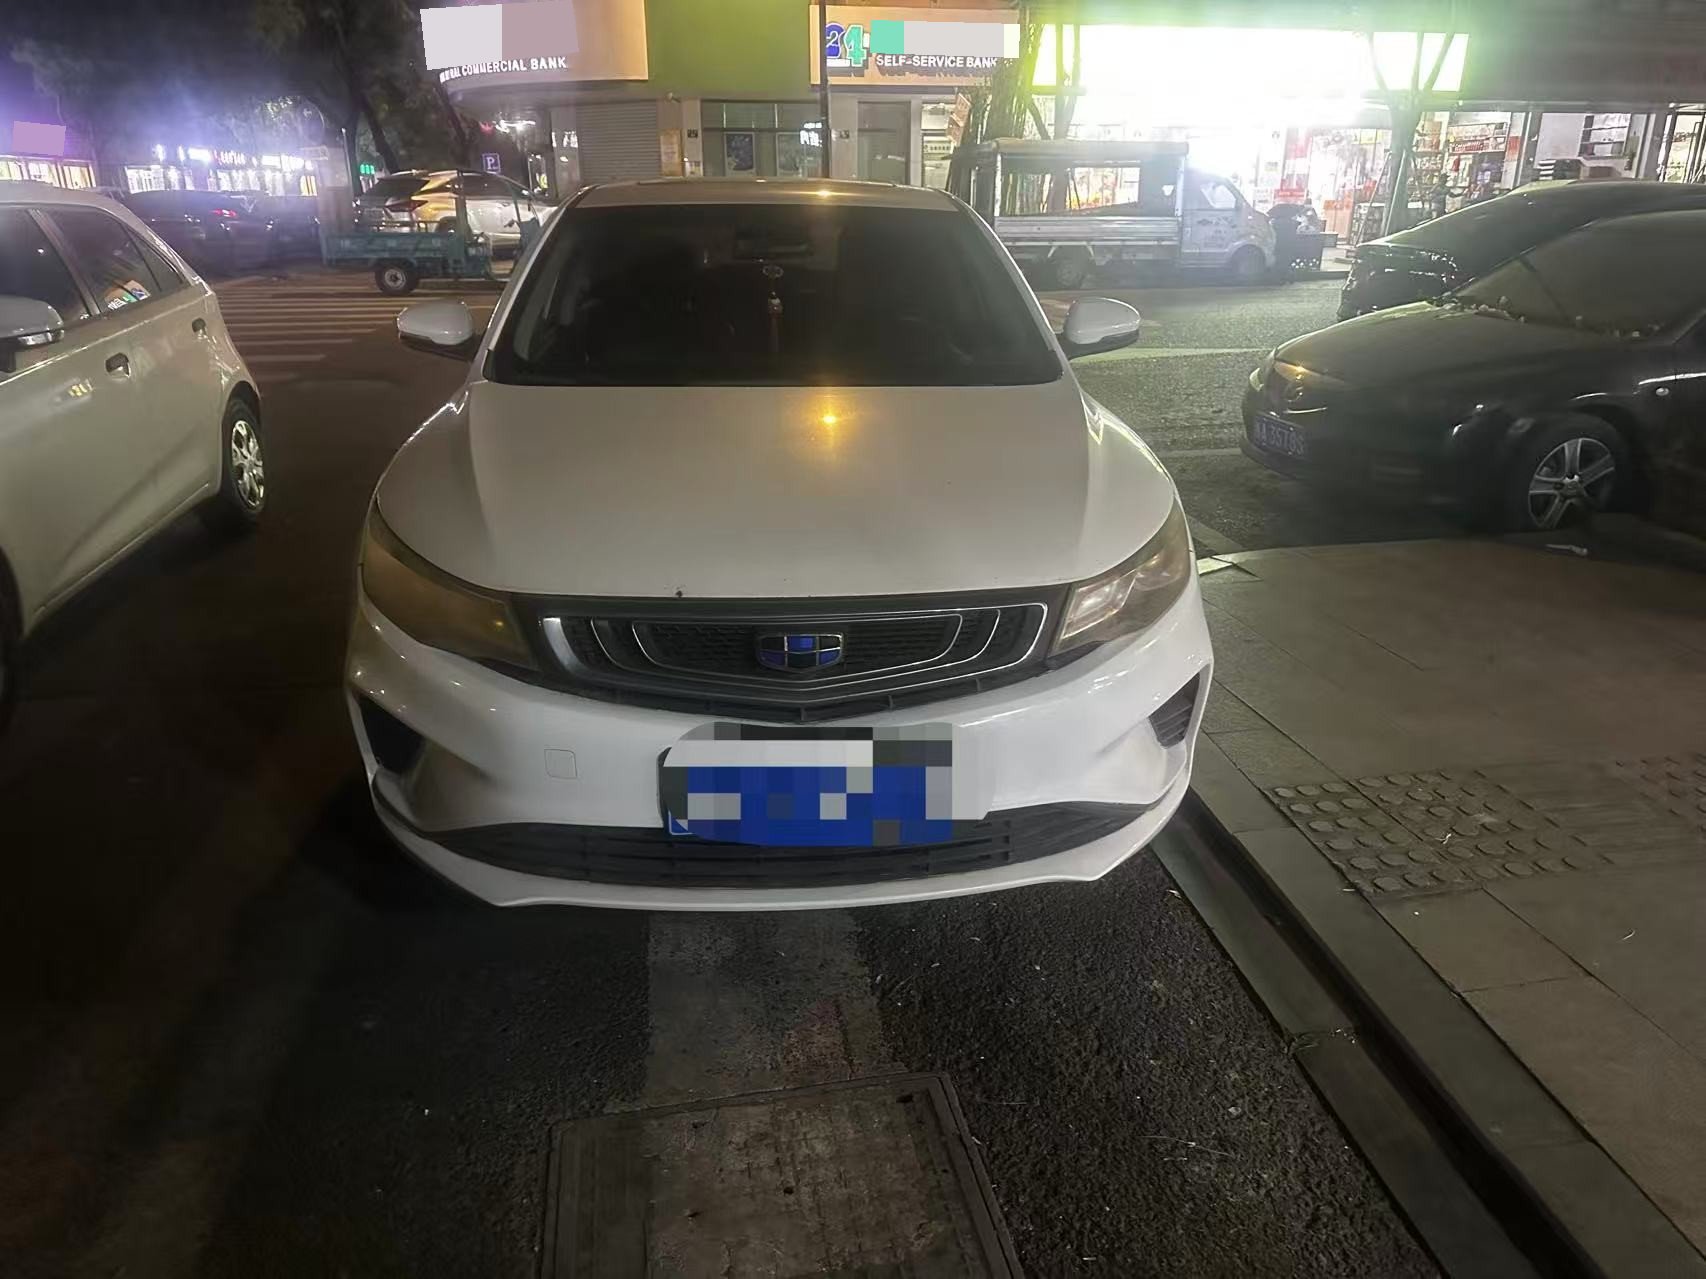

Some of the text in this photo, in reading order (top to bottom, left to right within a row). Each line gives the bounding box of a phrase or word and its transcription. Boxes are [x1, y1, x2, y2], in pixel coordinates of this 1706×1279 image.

[462, 59, 527, 76] COMMERCIAL
[530, 56, 567, 70] BANK
[876, 54, 998, 68] SELF-SERVICE BANK
